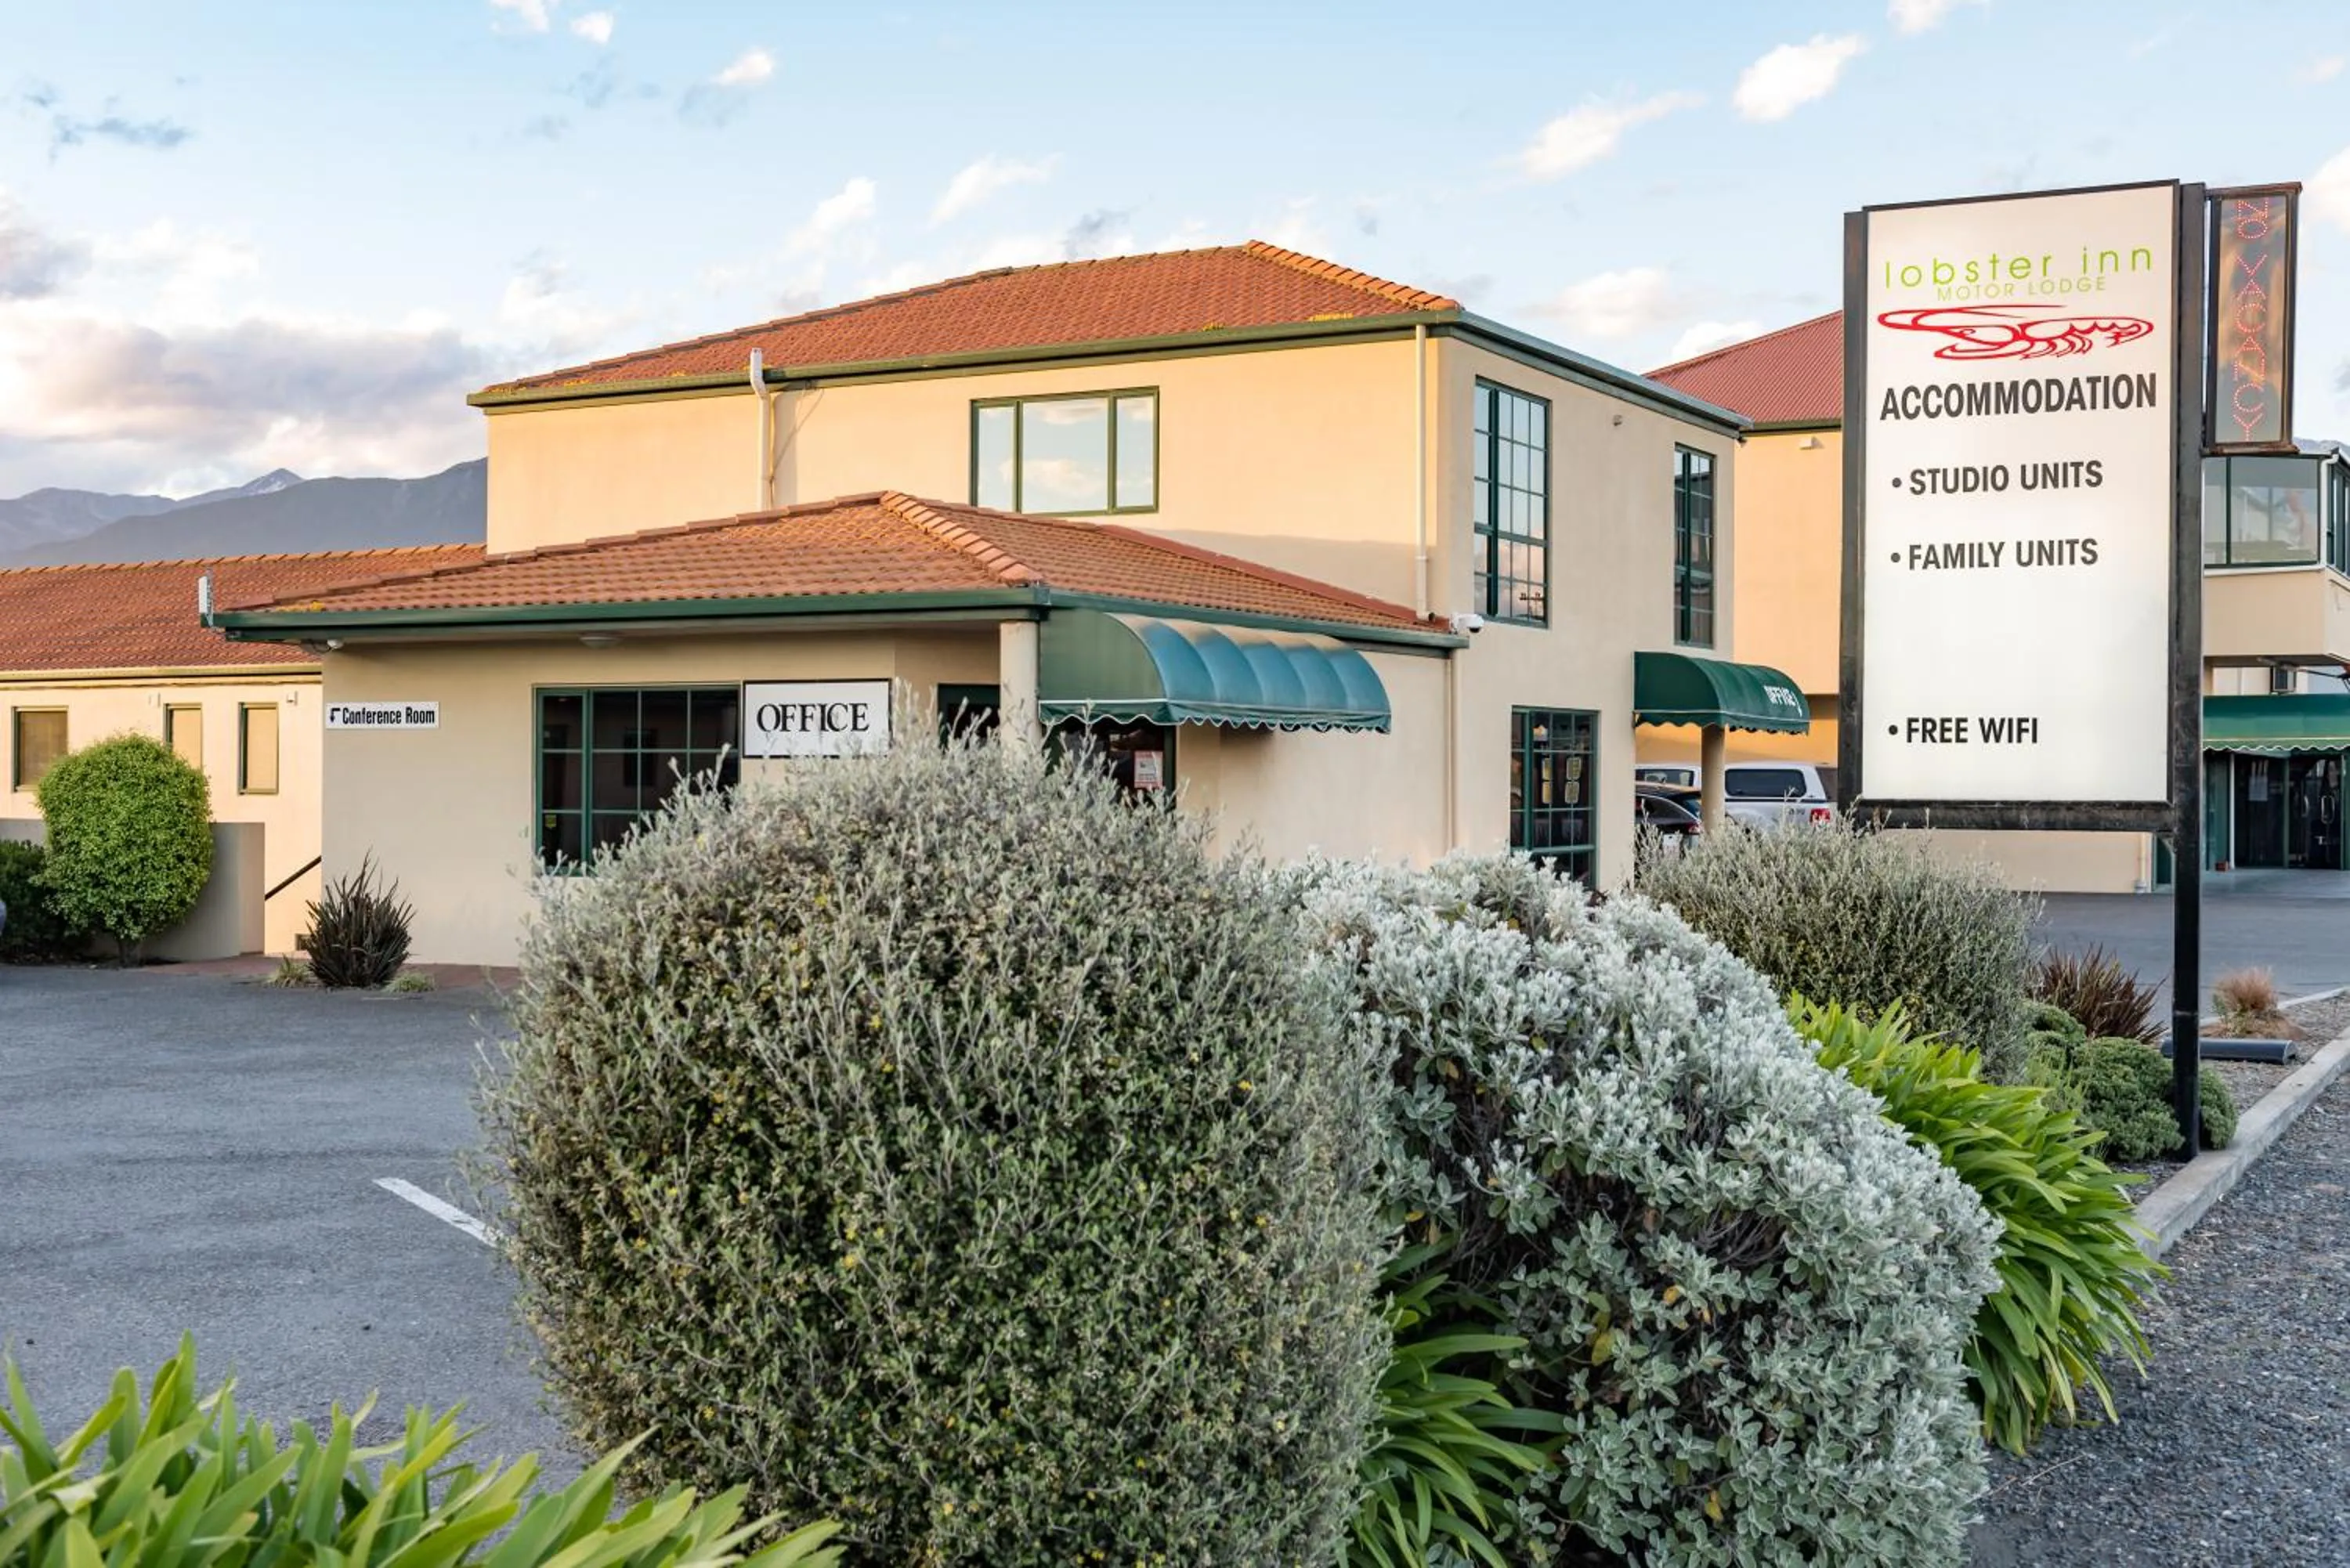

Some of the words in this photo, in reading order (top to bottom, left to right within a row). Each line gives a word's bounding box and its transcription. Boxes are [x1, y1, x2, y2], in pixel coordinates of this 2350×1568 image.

[1885, 251, 2053, 289] lobster
[2082, 246, 2152, 274] inn
[1937, 283, 2015, 302] MOTOR
[2028, 276, 2106, 296] LODGE
[2232, 253, 2269, 442] VACANCY
[1879, 373, 2157, 421] ACCOMMODATION
[1909, 464, 2009, 496] STUDIO
[2020, 460, 2104, 490] UNITS
[1908, 541, 2005, 571] FAMILY
[2016, 538, 2099, 568] UNITS
[342, 707, 402, 724] Conference
[405, 706, 435, 724] Room
[757, 703, 870, 732] OFFICE
[1906, 717, 1969, 743] FREE
[1979, 717, 2038, 743] WIFI
